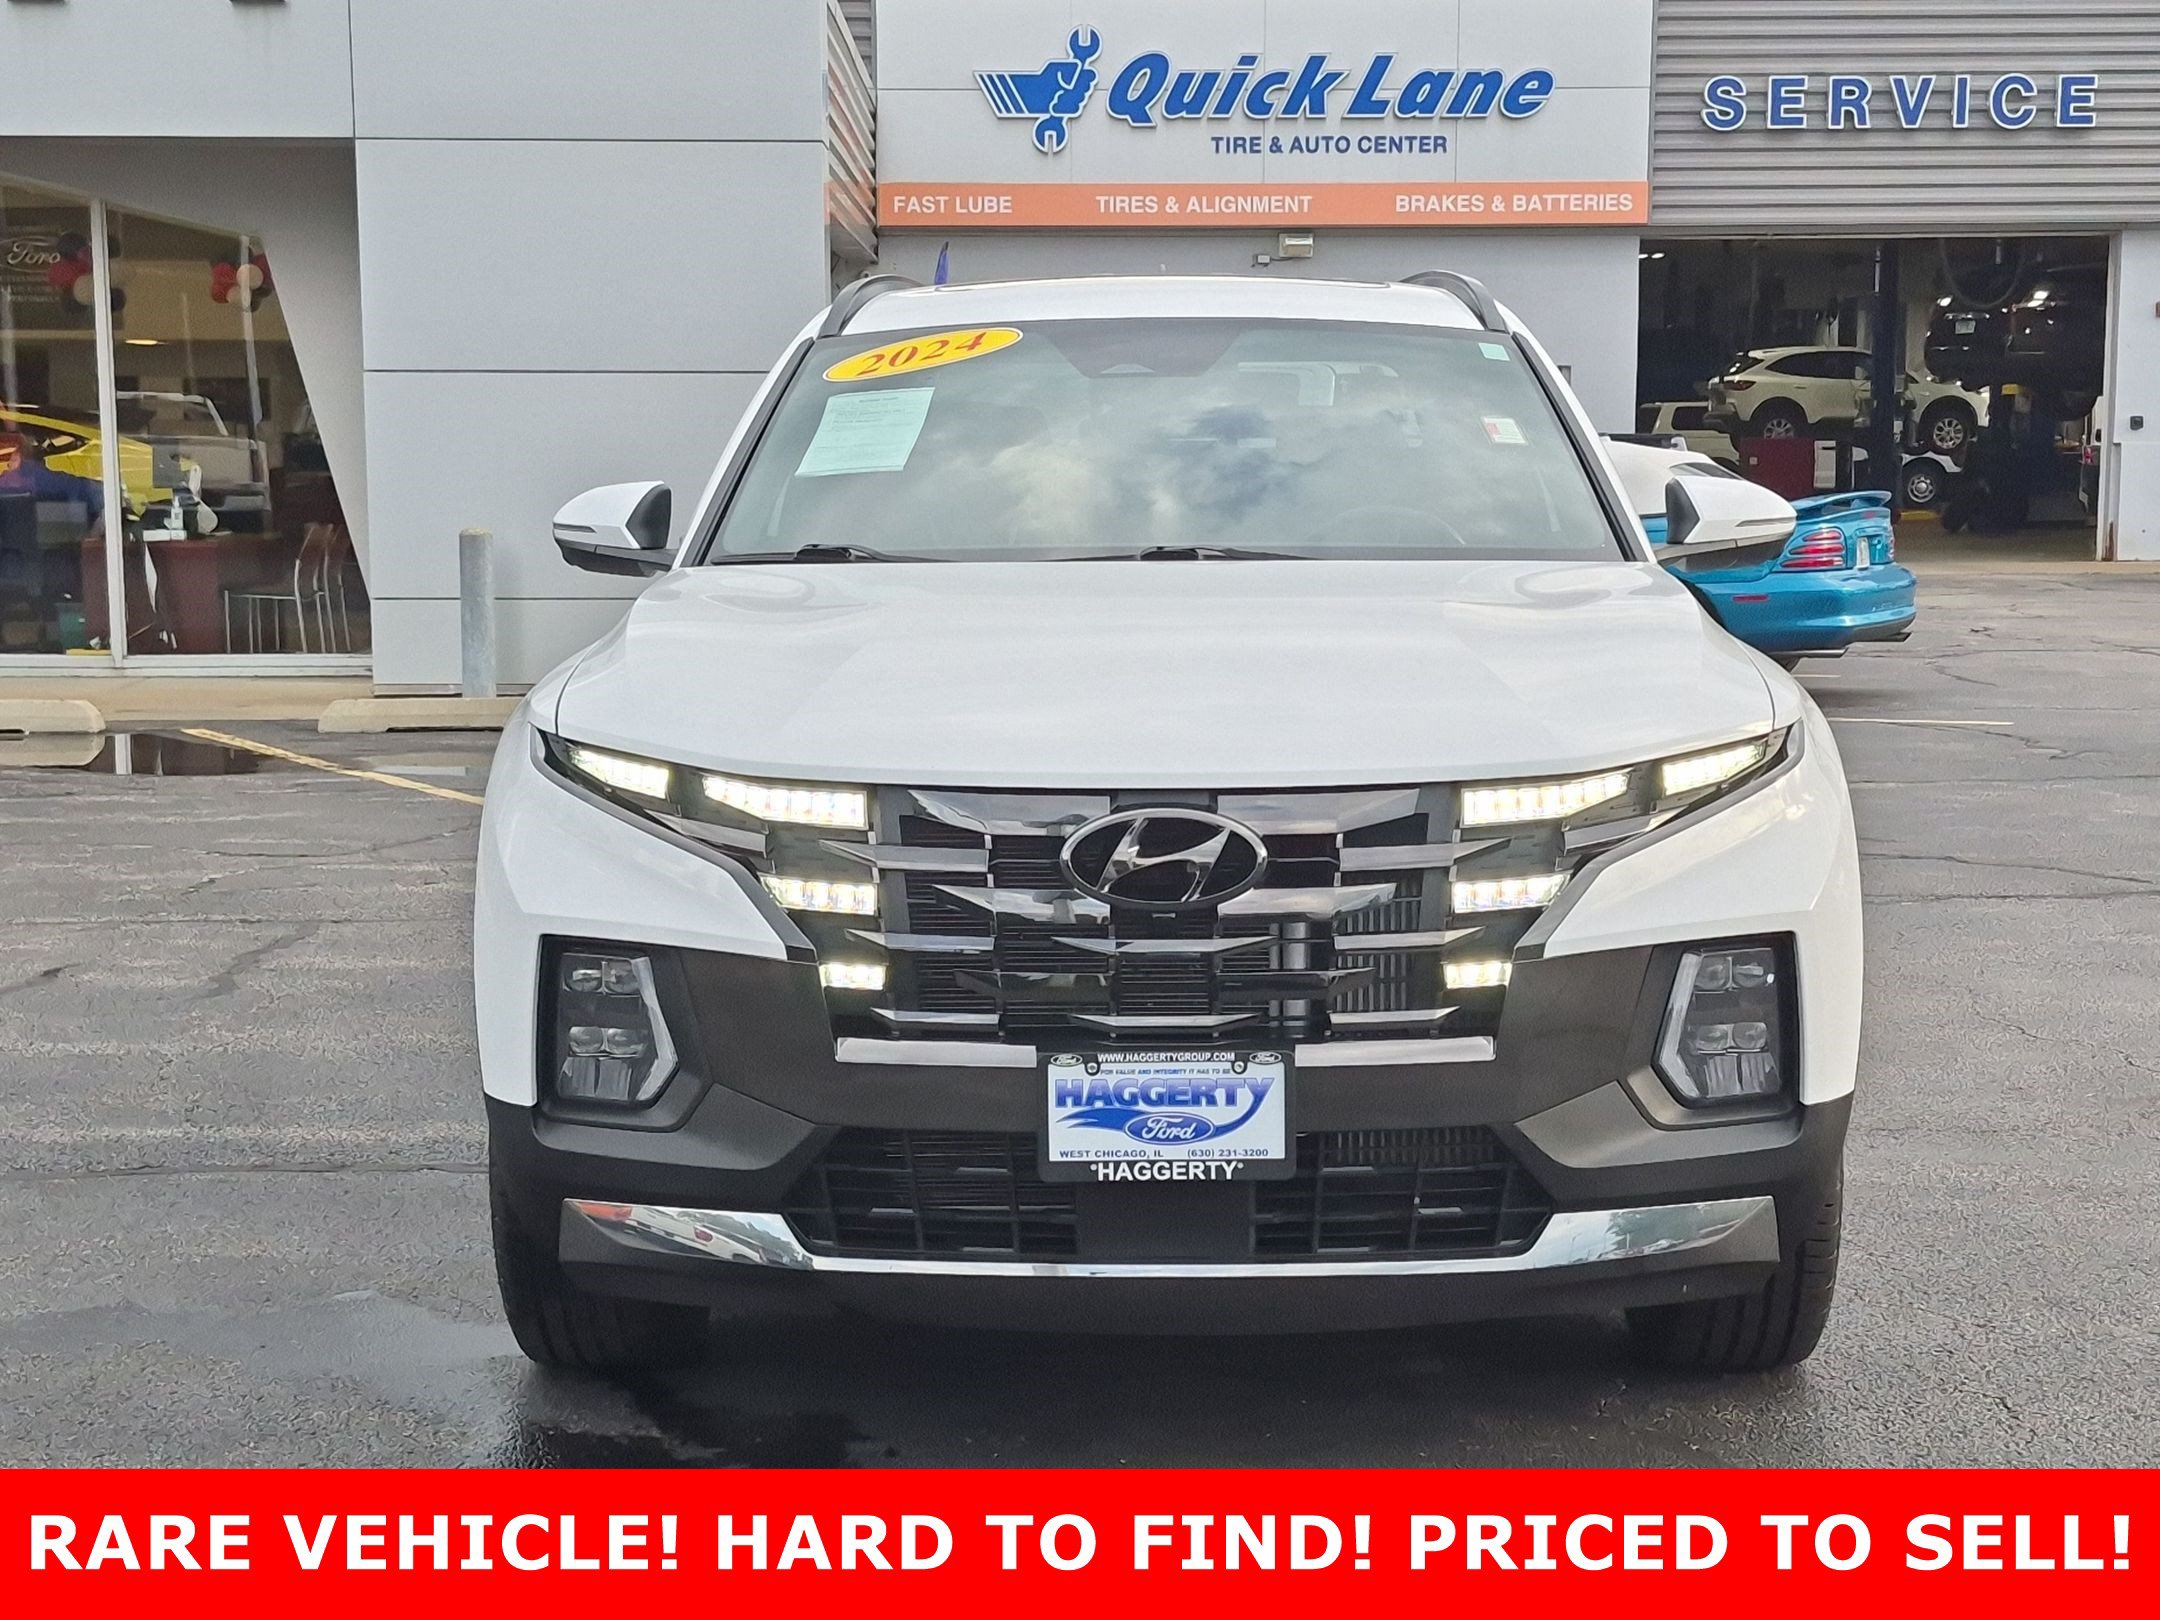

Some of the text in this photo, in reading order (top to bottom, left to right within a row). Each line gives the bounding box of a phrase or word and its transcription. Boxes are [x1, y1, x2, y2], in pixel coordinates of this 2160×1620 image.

[1107, 52, 1556, 128] Quick Lane
[1702, 73, 2099, 131] SERVICE
[1212, 135, 1449, 154] TIRE & AUTO CENTER
[893, 196, 1012, 214] FAST LUBE
[1095, 195, 1313, 214] TIRES & ALIGNMENT
[1395, 194, 1634, 213] BRAKES & BATTERIES
[856, 332, 987, 377] 2024
[1097, 1052, 1236, 1063] WWW.HAGGERTYGROUP.COM
[1055, 1077, 1275, 1108] HAGGERTY
[1141, 1116, 1196, 1140] Ford
[1059, 1148, 1269, 1159] WEST CHICAGO, IL (630) 231-3200
